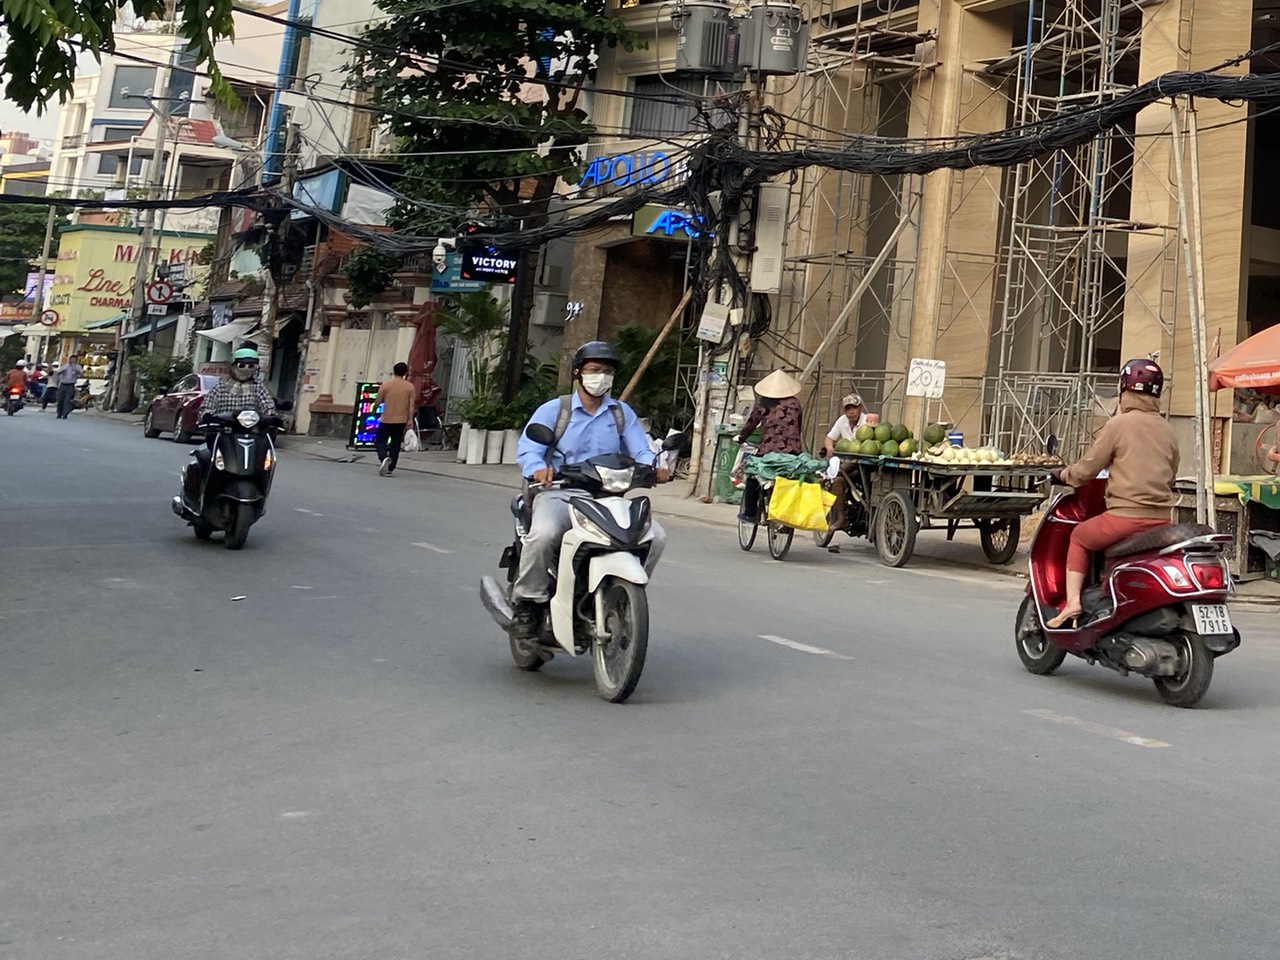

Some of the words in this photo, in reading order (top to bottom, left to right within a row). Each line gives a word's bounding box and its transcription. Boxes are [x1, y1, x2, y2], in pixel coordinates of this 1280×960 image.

[579, 151, 670, 187] APOLLO
[471, 256, 517, 270] VICTORY
[77, 268, 122, 292] Line
[1198, 605, 1225, 619] 52-T8
[1201, 619, 1229, 633] 7916
